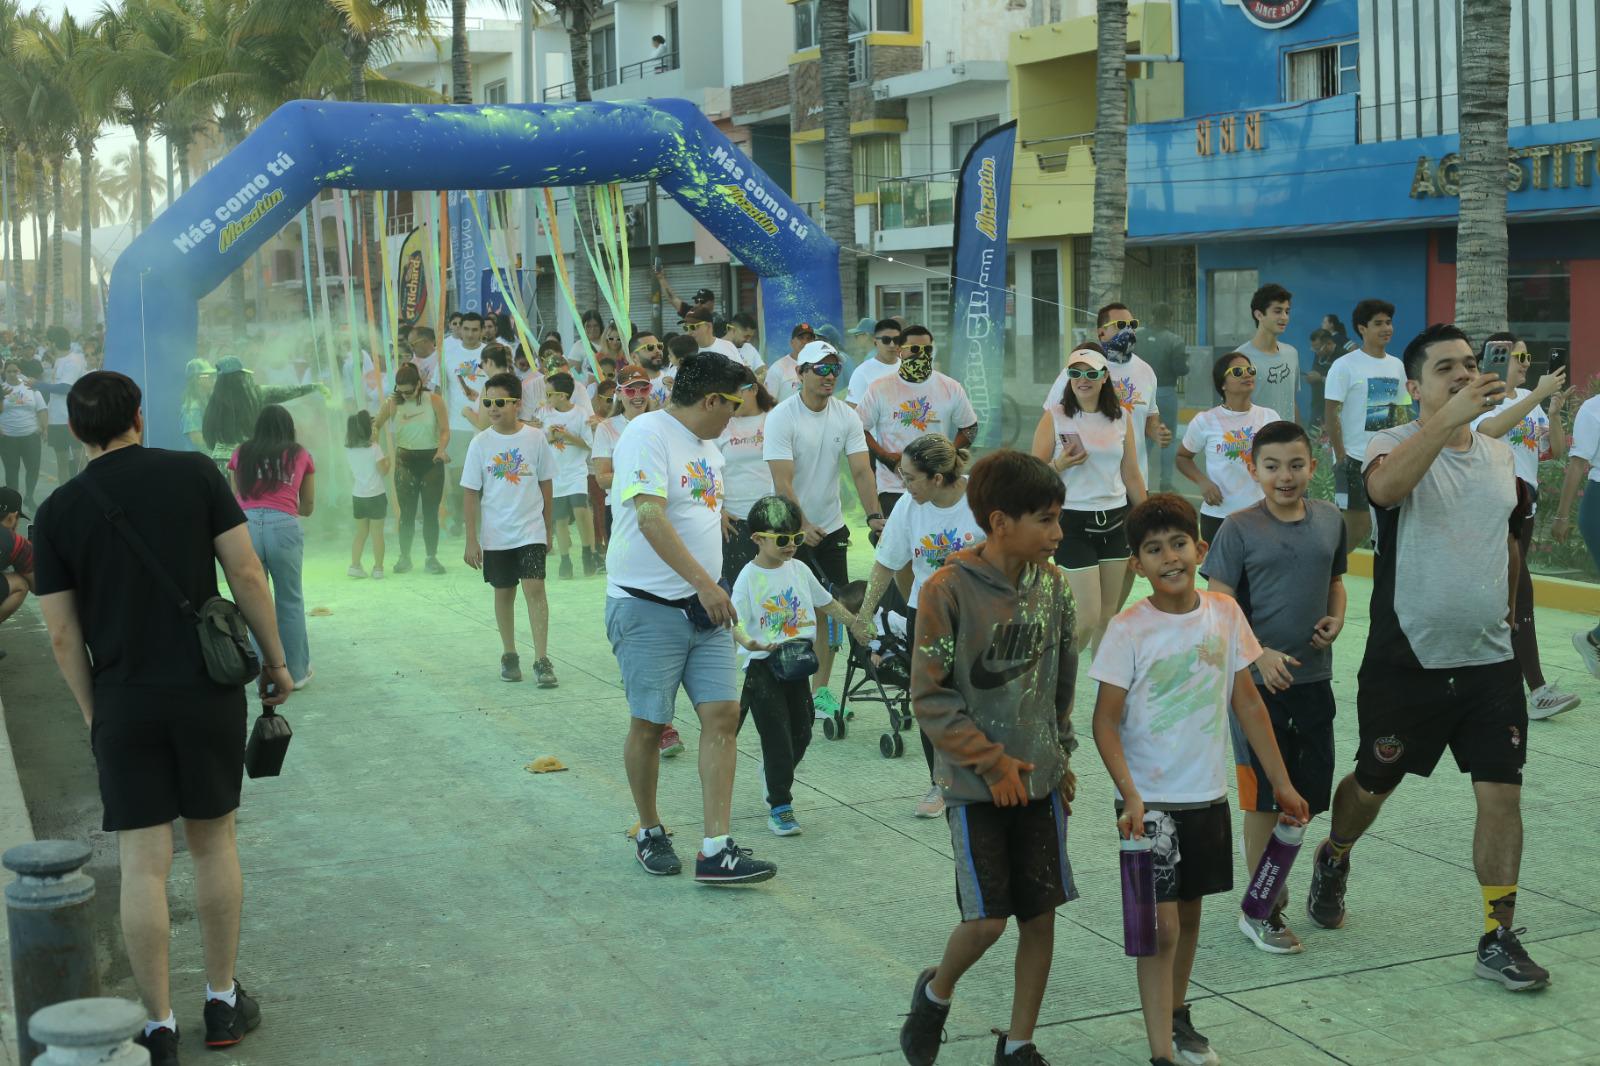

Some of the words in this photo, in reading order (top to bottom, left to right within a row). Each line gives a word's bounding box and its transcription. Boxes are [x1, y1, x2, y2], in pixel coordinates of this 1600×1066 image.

[1255, 2, 1277, 18] SINCE
[711, 145, 745, 180] Más
[744, 178, 788, 220] como
[788, 216, 809, 240] tú
[1409, 143, 1600, 198] AGSTIT
[173, 223, 217, 255] Más
[215, 174, 270, 221] como
[266, 151, 296, 177] tú
[405, 258, 421, 305] Richard
[641, 848, 653, 861] N
[720, 853, 740, 871] N
